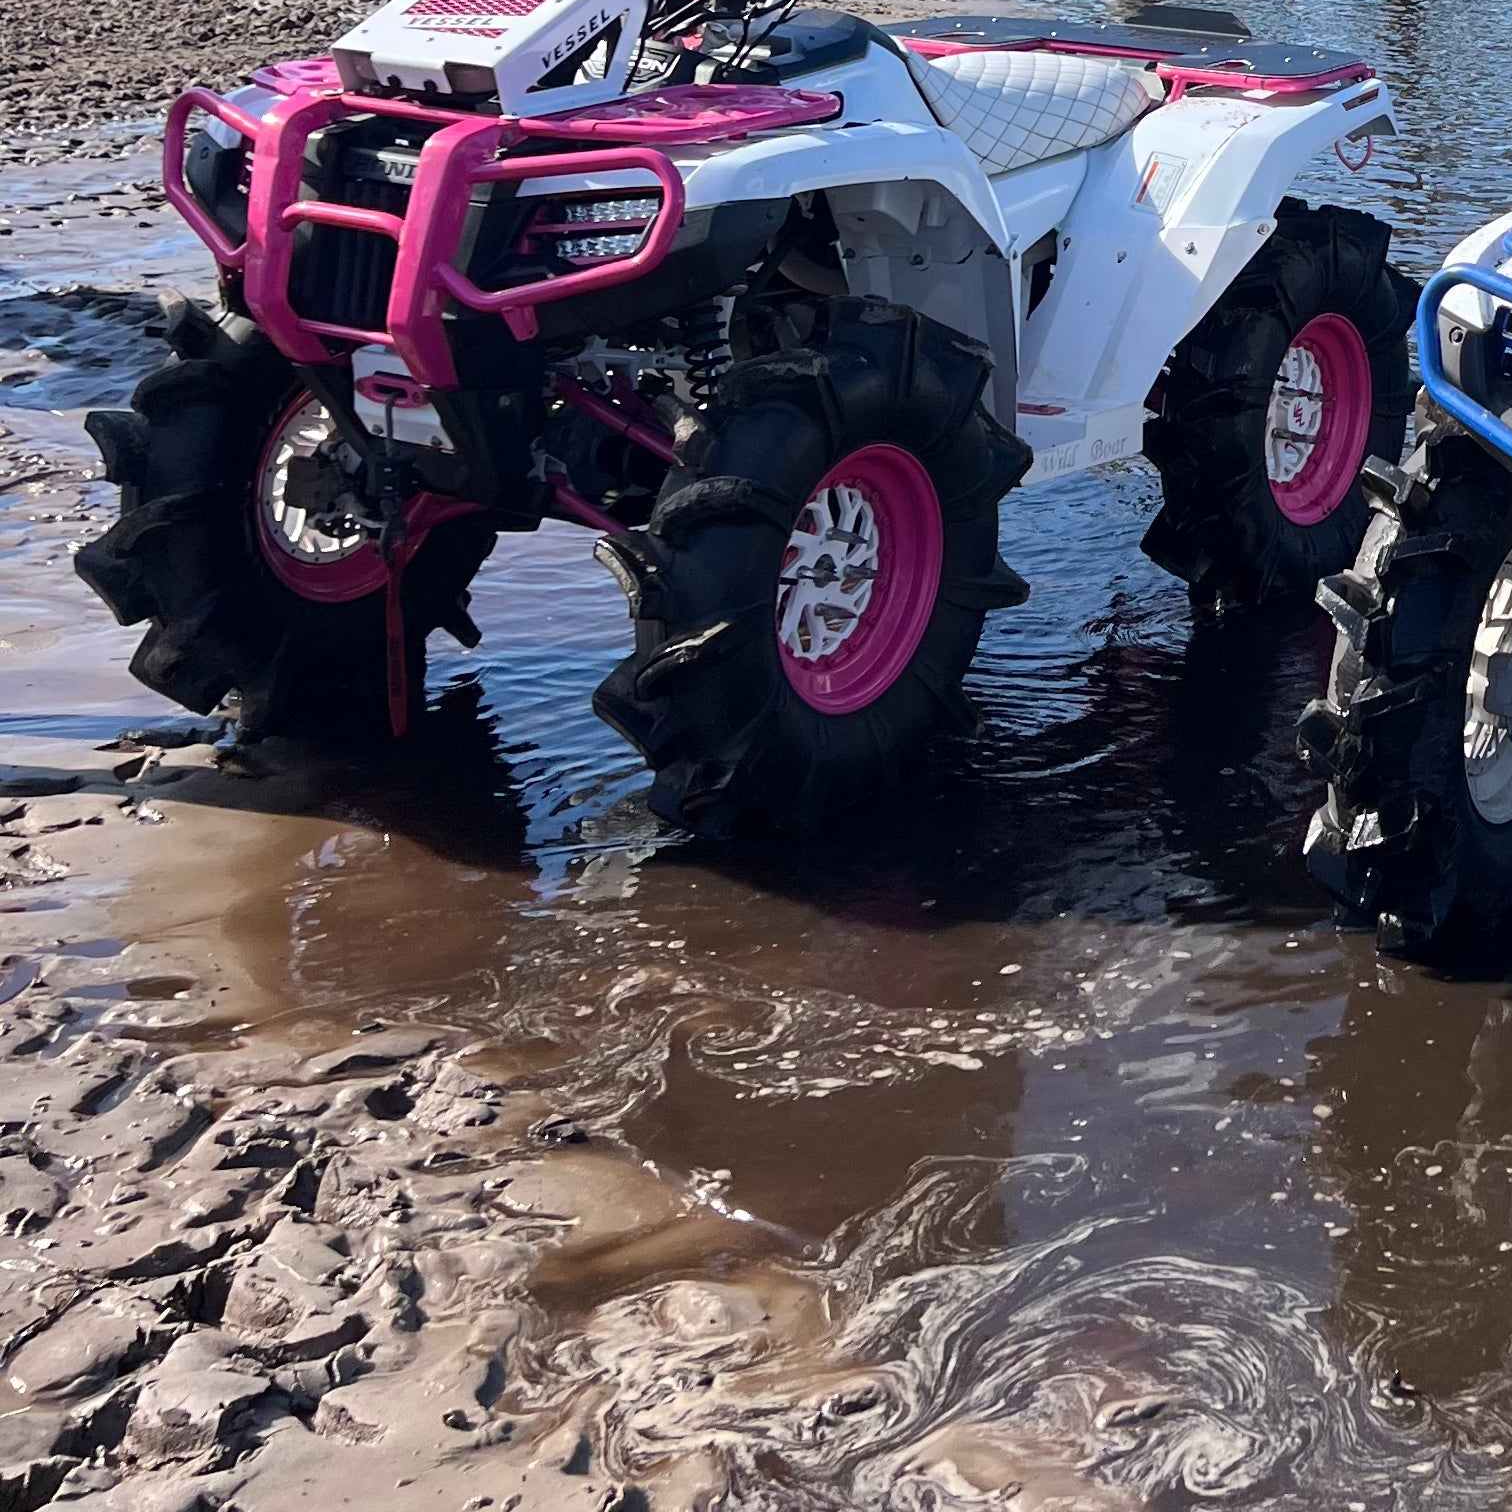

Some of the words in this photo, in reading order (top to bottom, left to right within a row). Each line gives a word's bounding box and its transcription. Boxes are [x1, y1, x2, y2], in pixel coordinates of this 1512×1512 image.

[407, 17, 495, 26] VESSEL
[541, 8, 612, 69] VESSEL
[1040, 443, 1080, 473] Wild
[1090, 436, 1128, 461] Boar
